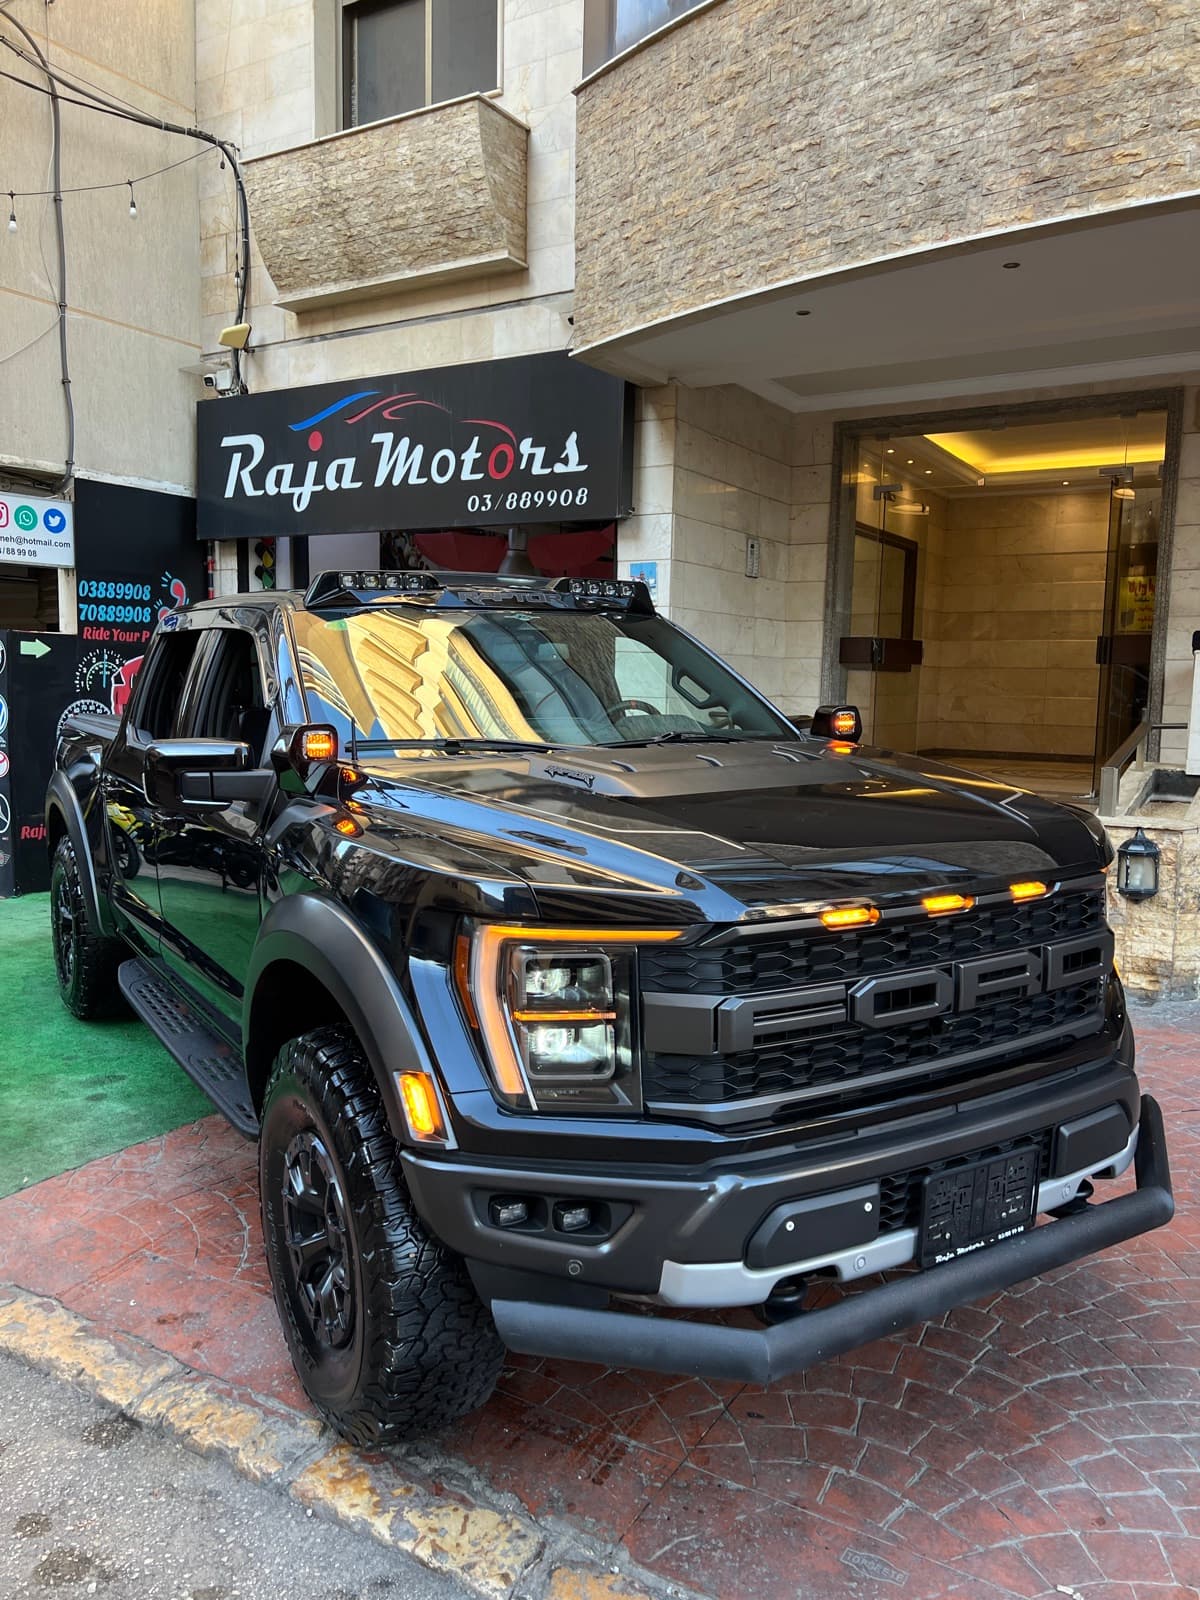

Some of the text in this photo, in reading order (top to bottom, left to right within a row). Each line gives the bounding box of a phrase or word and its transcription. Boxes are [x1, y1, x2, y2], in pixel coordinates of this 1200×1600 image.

[220, 430, 589, 512] Raja Motors
[467, 487, 589, 512] 03/889908
[79, 580, 151, 600] 03889908
[458, 591, 568, 609] RAPTOR
[79, 603, 151, 623] 70889908
[83, 626, 150, 643] Ride Your P
[718, 929, 1113, 1055] FORD
